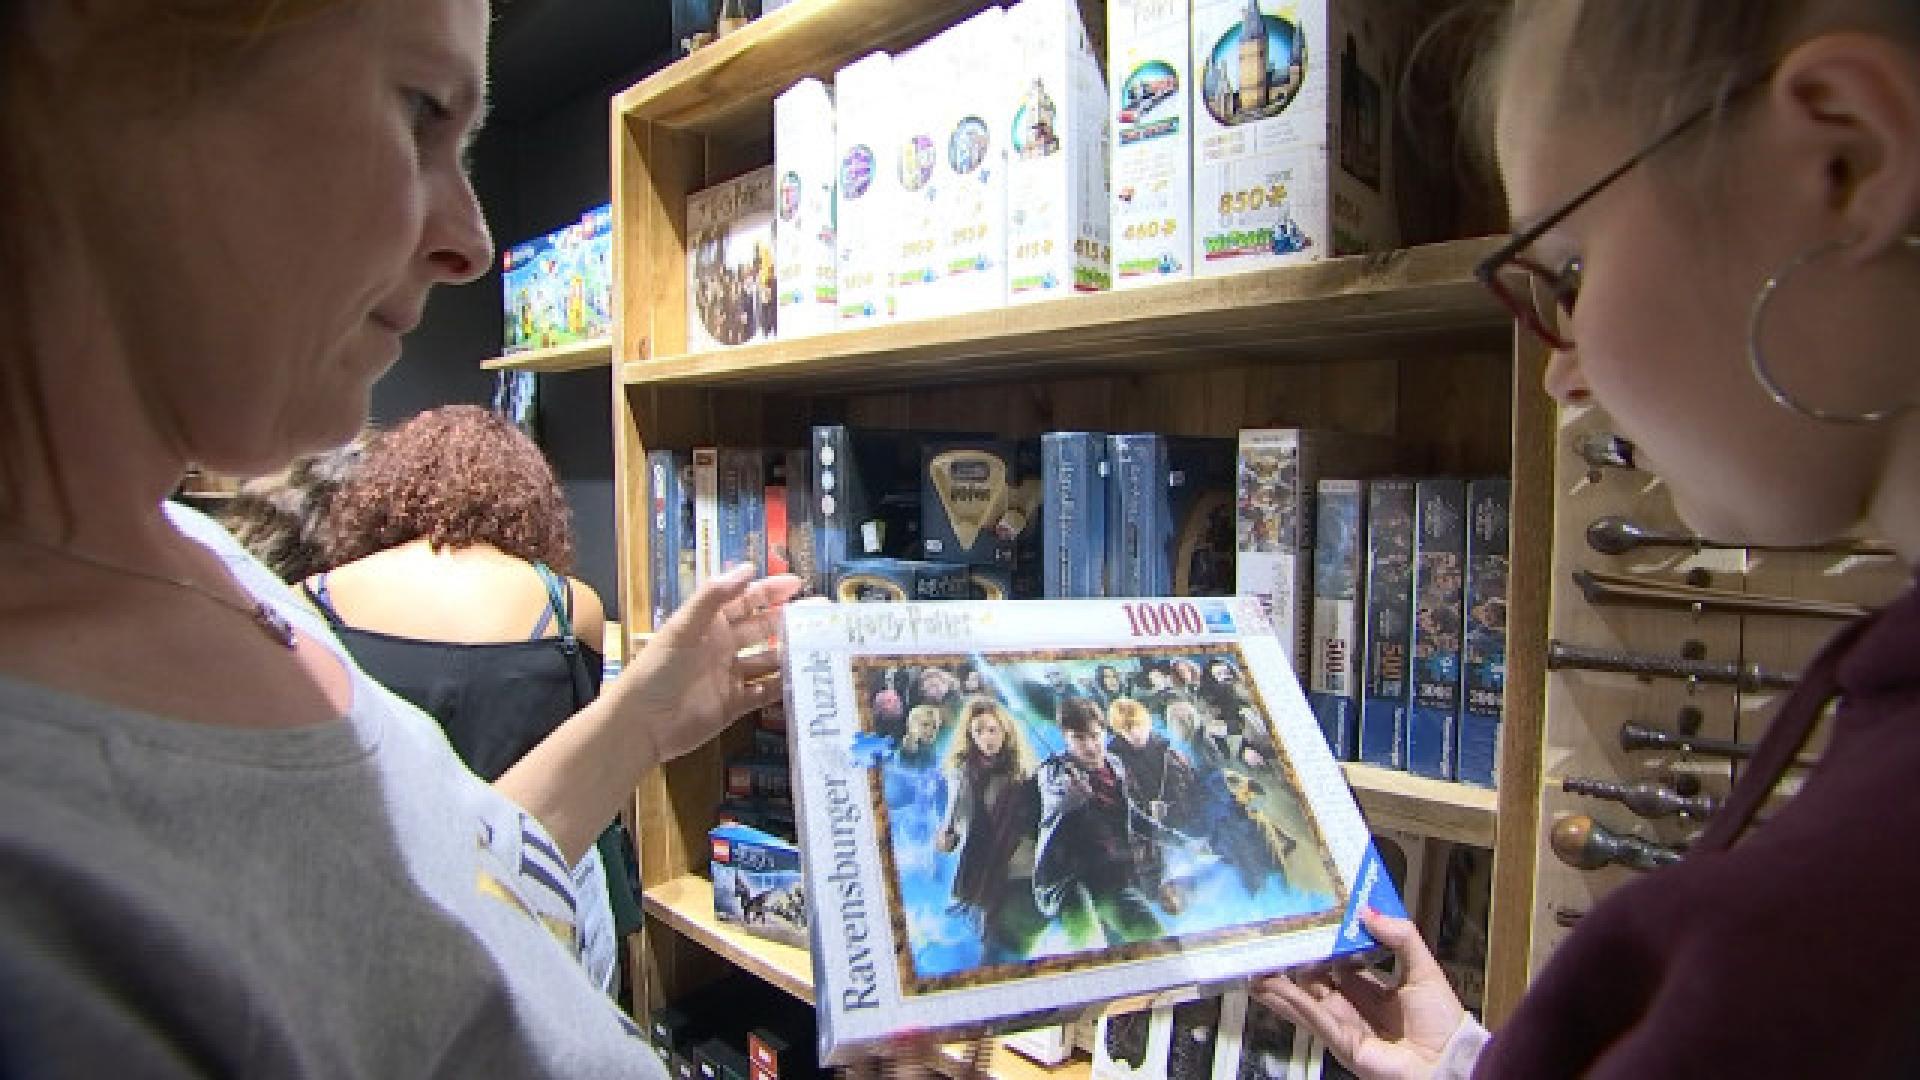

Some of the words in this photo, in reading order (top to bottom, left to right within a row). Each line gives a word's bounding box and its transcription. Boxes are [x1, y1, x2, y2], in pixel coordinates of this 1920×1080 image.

[1218, 184, 1266, 217] 850
[1123, 602, 1204, 637] 1000
[1325, 638, 1348, 674] 500
[1381, 642, 1403, 679] 500
[809, 652, 842, 740] Puzzle
[825, 774, 880, 1013] Ravensburger
